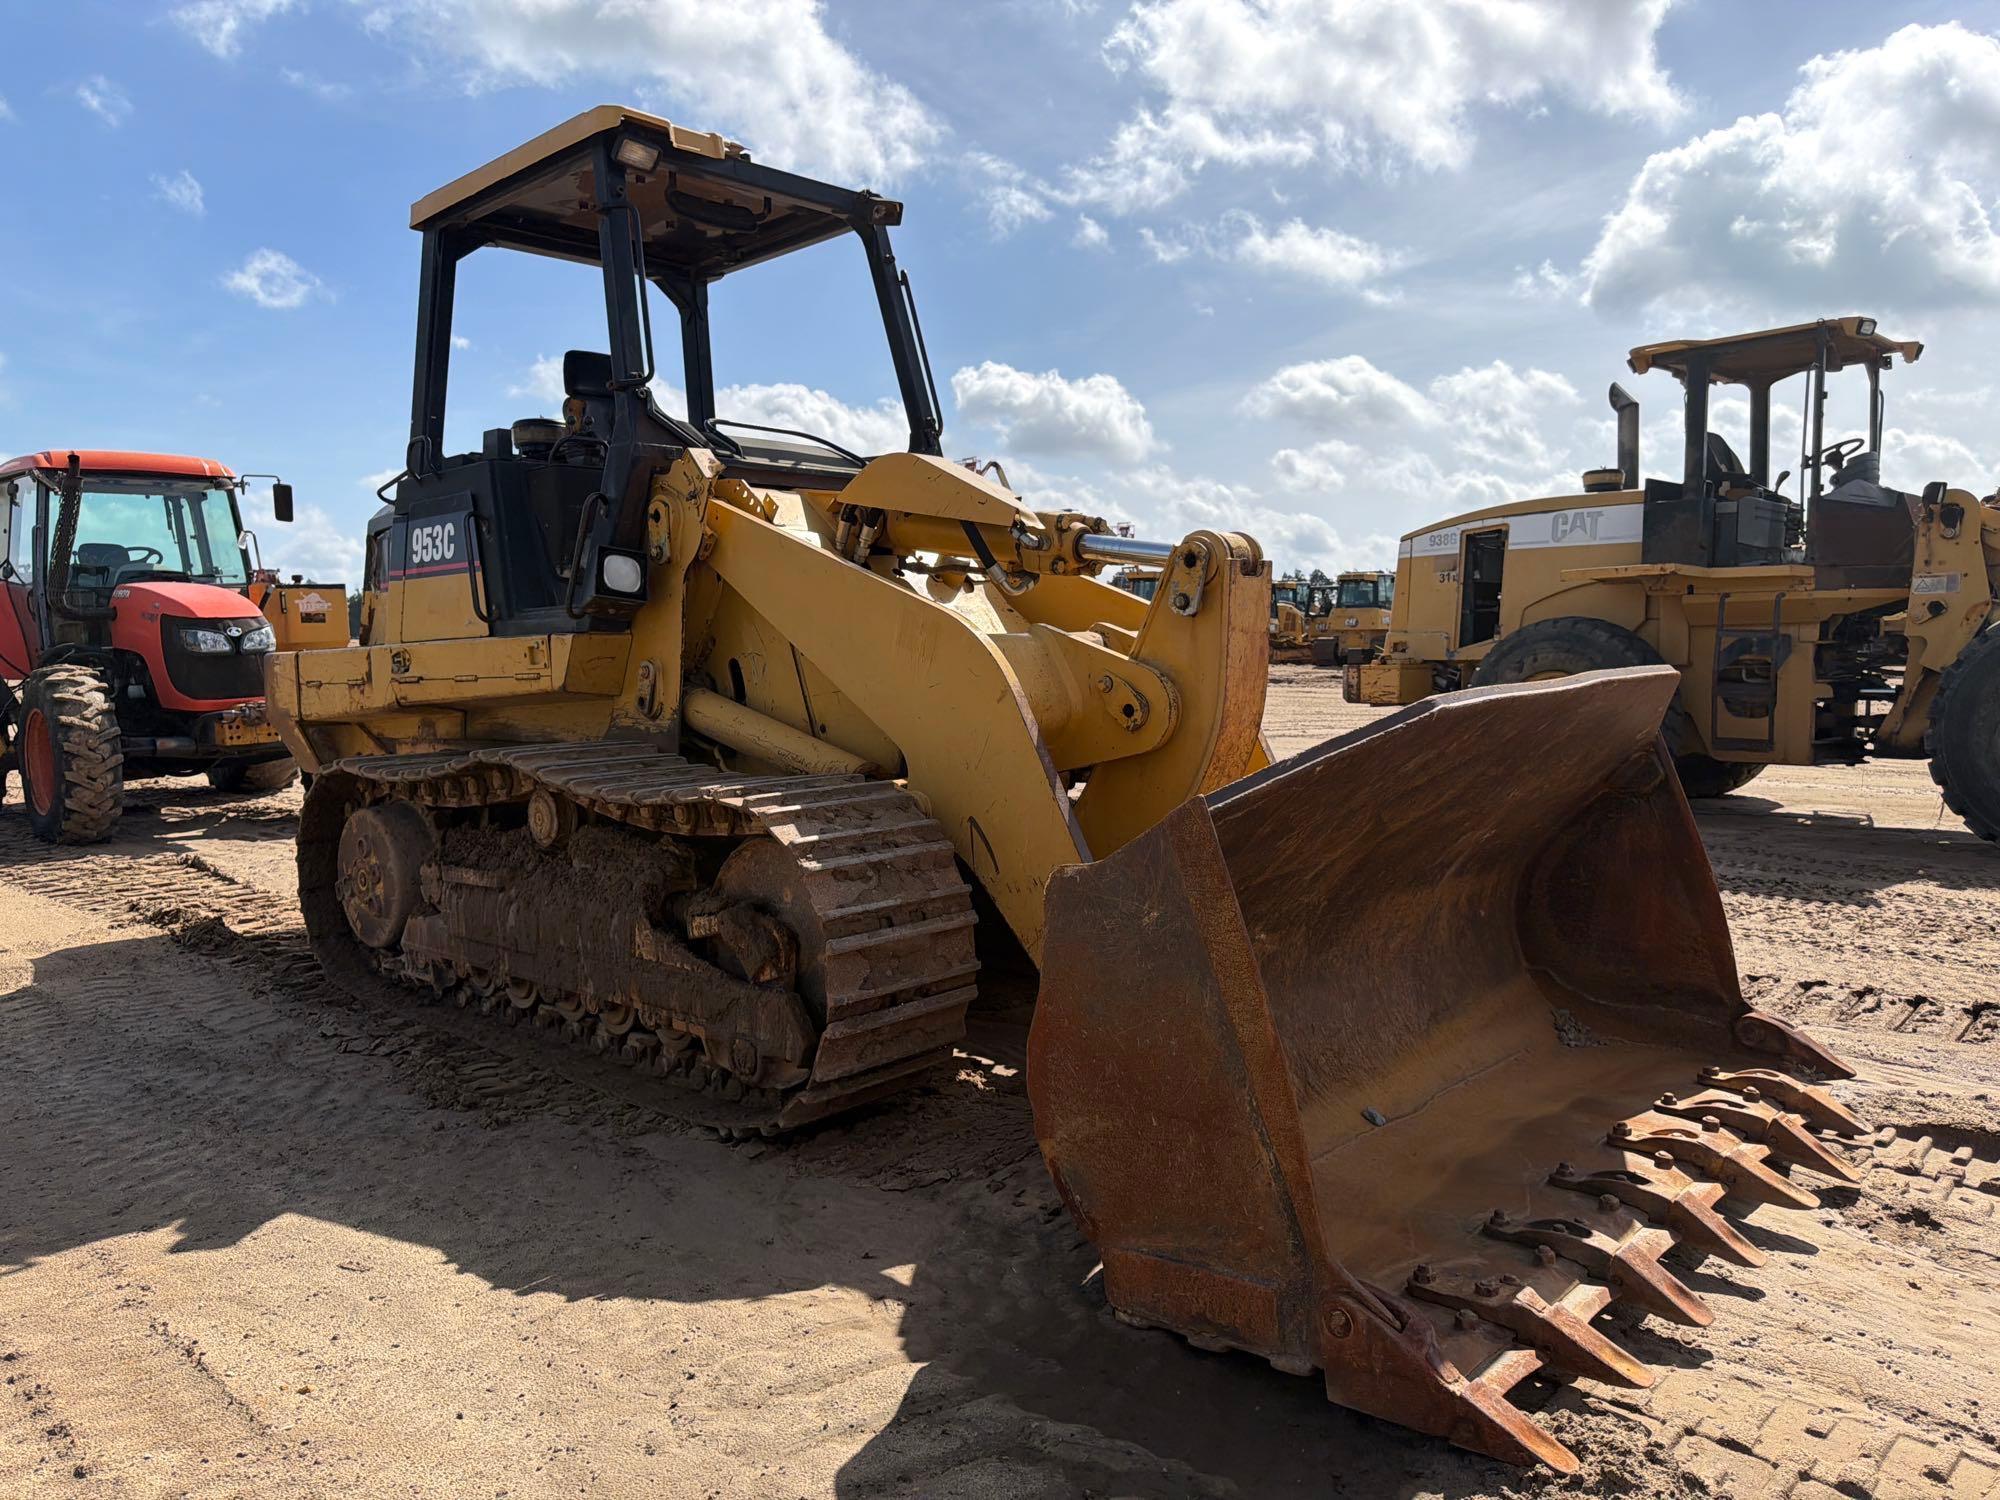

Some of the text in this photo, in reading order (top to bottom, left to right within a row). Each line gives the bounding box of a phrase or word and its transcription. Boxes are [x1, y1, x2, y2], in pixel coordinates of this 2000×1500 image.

[412, 522, 455, 564] 953C
[1429, 532, 1458, 547] 938G
[1551, 510, 1605, 543] CAT
